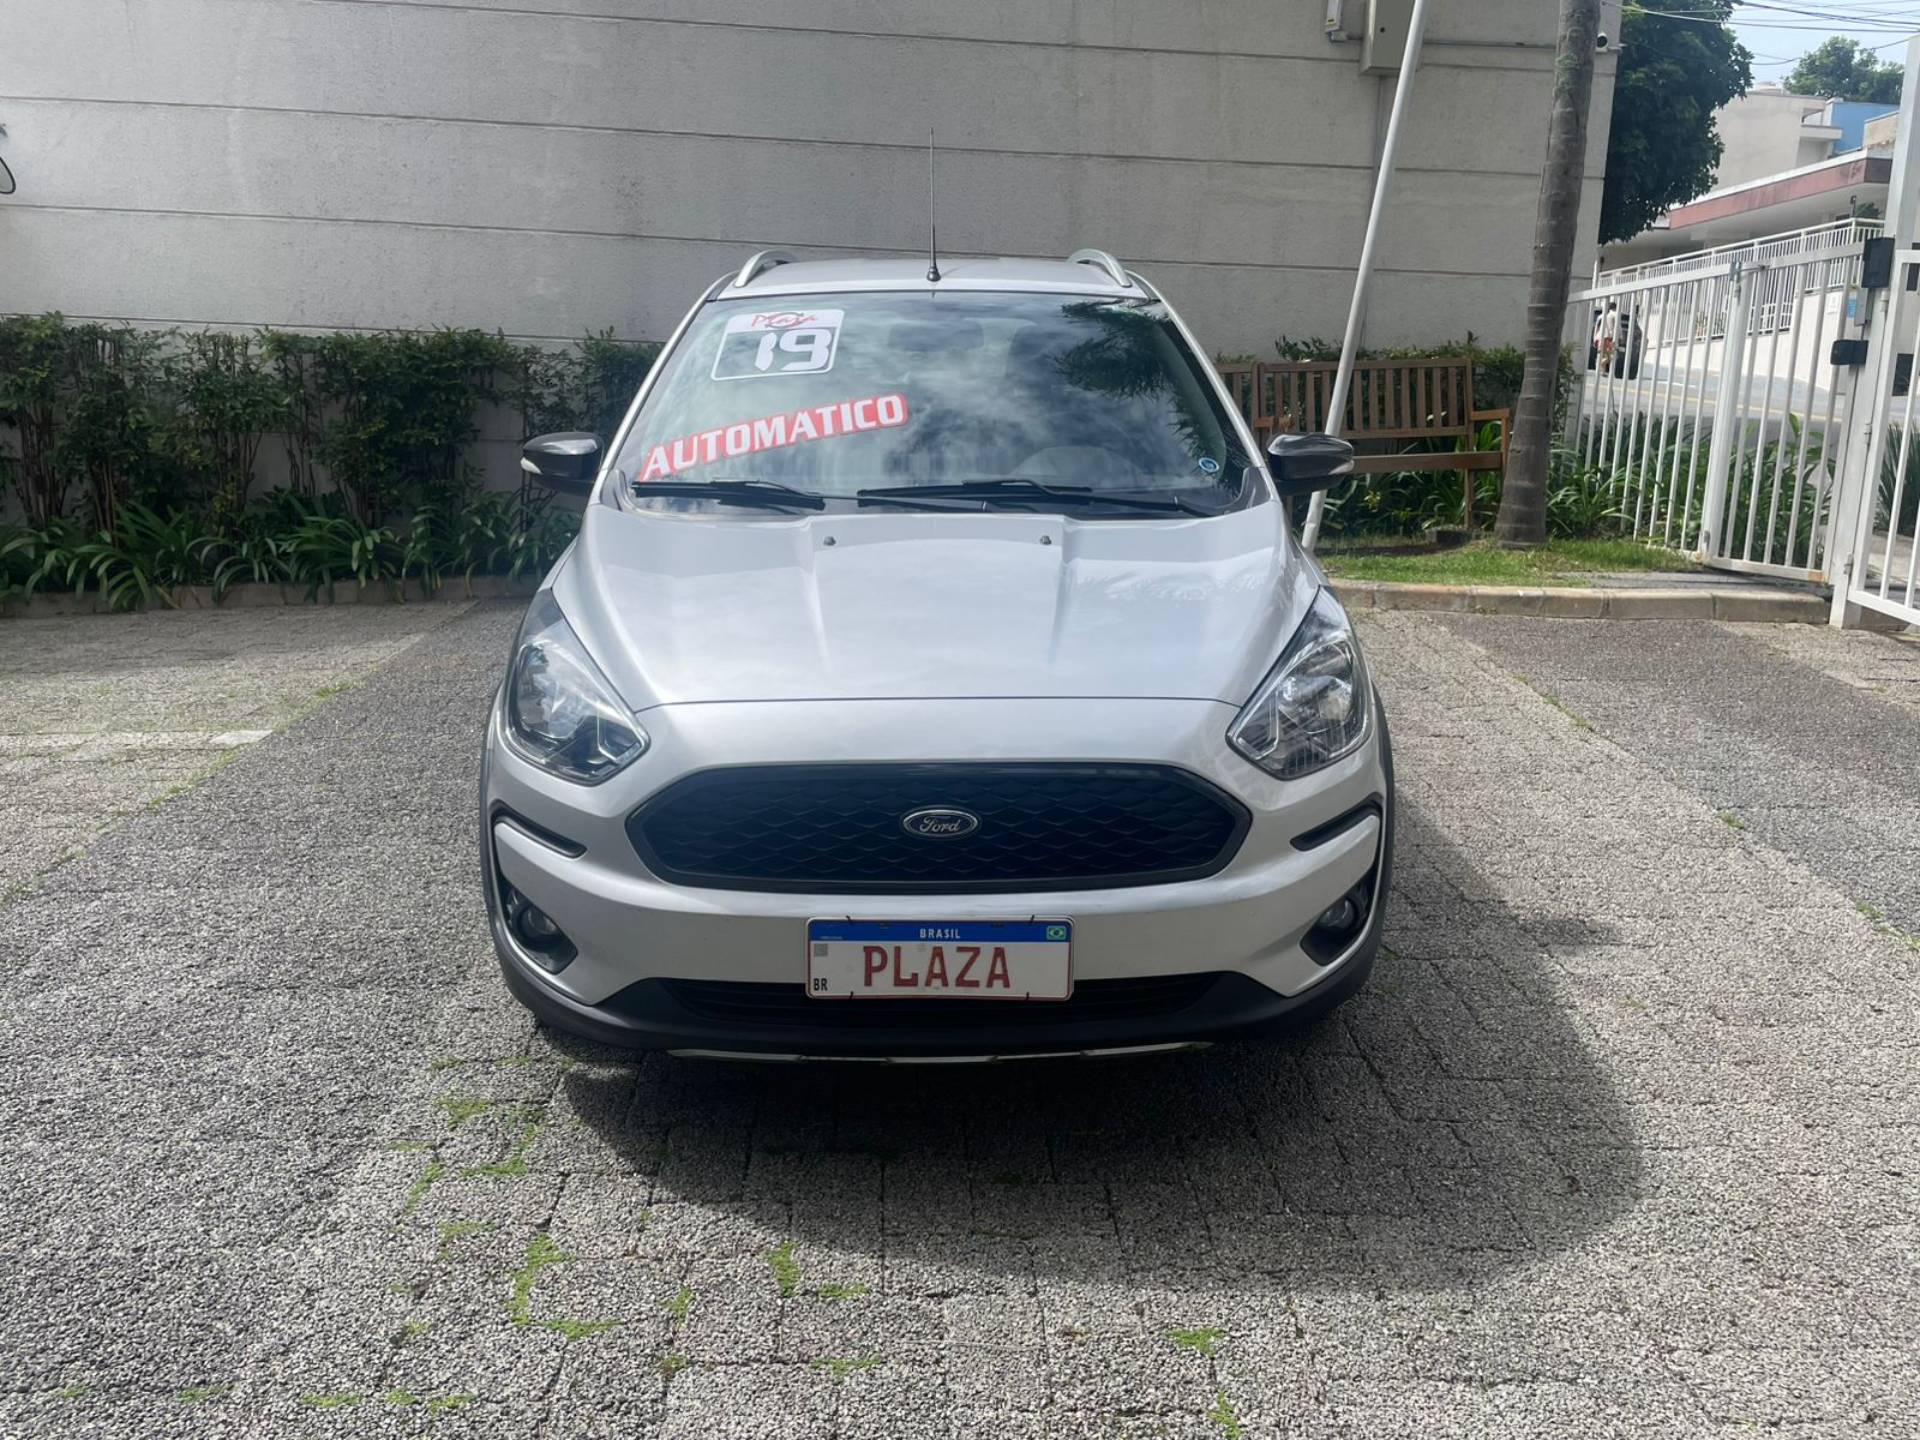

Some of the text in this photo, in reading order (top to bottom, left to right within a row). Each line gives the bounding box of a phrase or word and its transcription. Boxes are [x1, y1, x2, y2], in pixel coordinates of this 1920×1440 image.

[754, 328, 832, 371] 19
[640, 394, 905, 481] AUTOMATICO
[919, 815, 961, 832] Ford
[919, 928, 961, 939] BRASIL
[863, 945, 1011, 988] PLAZA
[813, 978, 828, 991] BR
